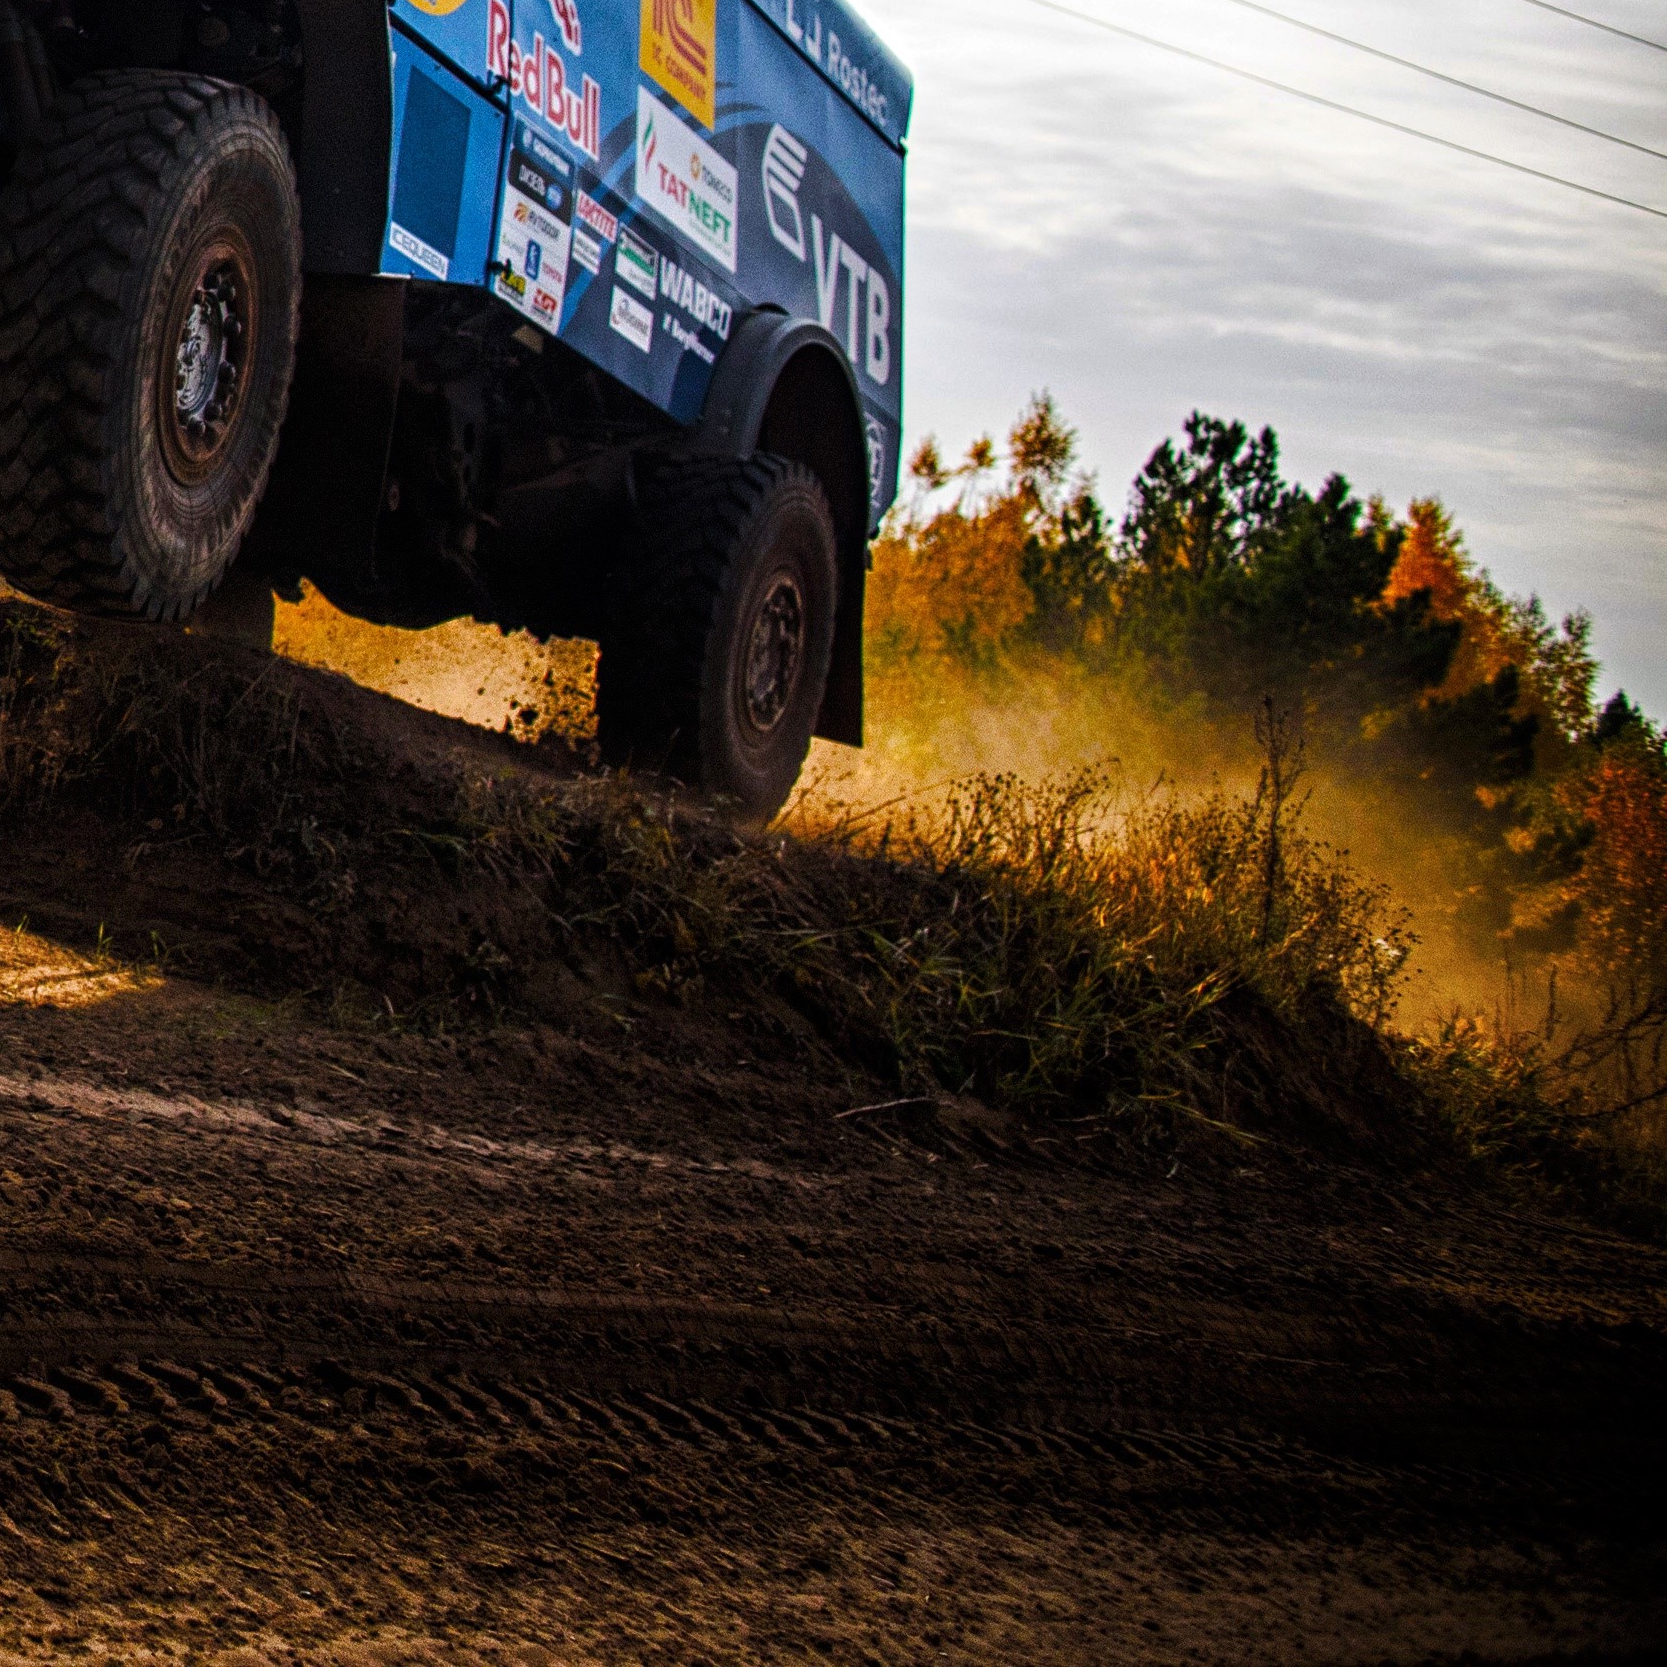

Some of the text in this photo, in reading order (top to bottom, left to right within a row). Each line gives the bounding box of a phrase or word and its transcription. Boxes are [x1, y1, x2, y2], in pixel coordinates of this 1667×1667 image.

[828, 30, 889, 129] Rostec
[577, 191, 616, 240] LOCTITE
[657, 161, 733, 244] TATNEFT
[660, 254, 734, 341] WABCO
[811, 213, 890, 386] VTB
